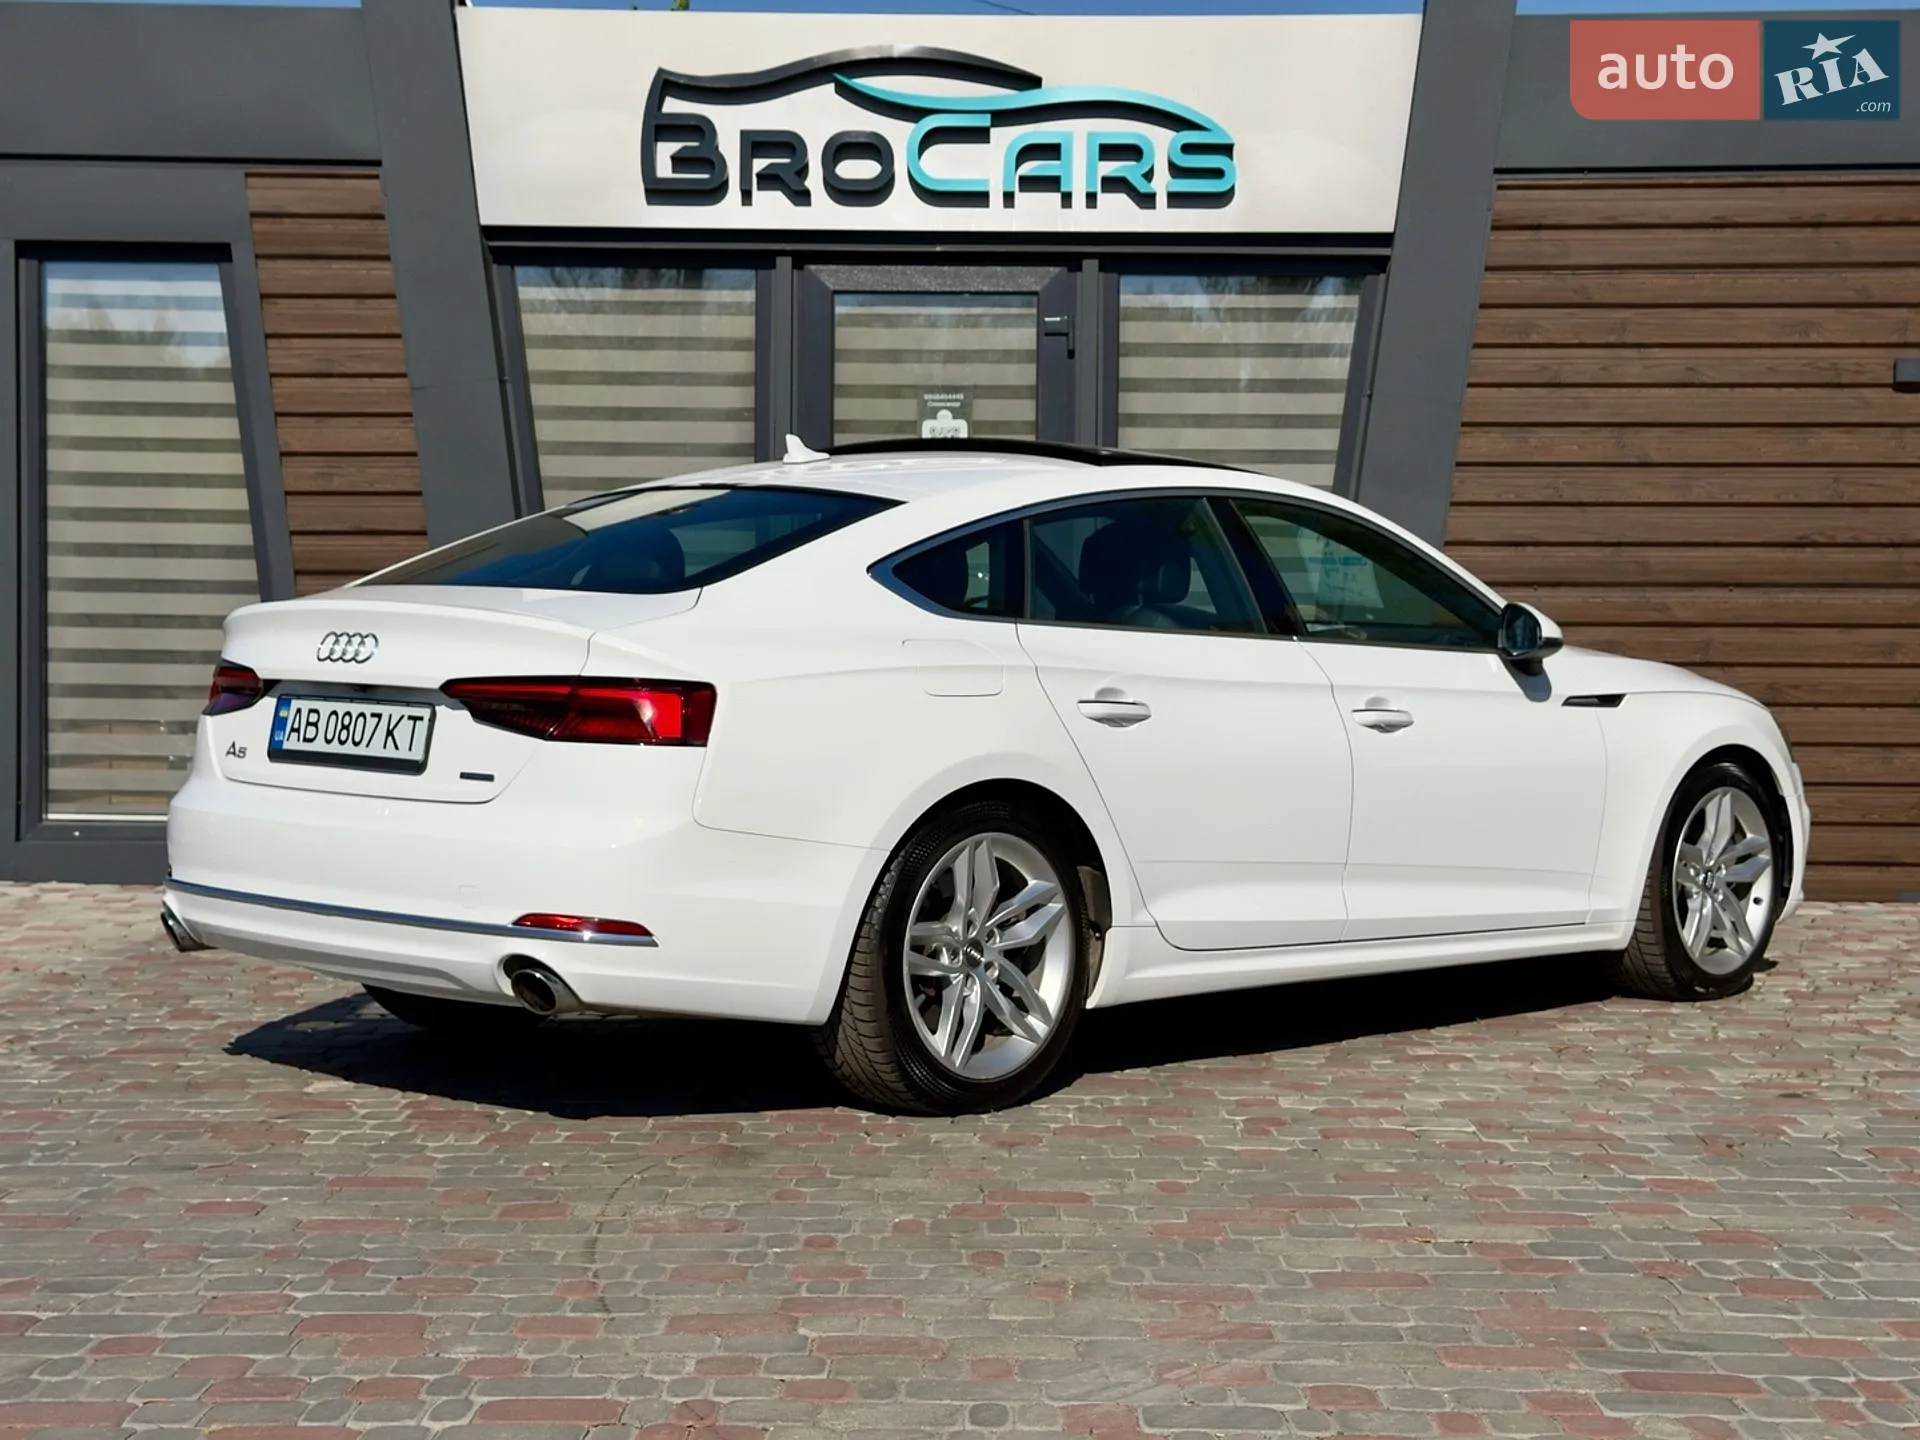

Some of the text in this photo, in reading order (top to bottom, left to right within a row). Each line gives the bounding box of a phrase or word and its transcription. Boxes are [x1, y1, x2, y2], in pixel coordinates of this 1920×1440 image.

[286, 707, 424, 752] AB 0807 KT
